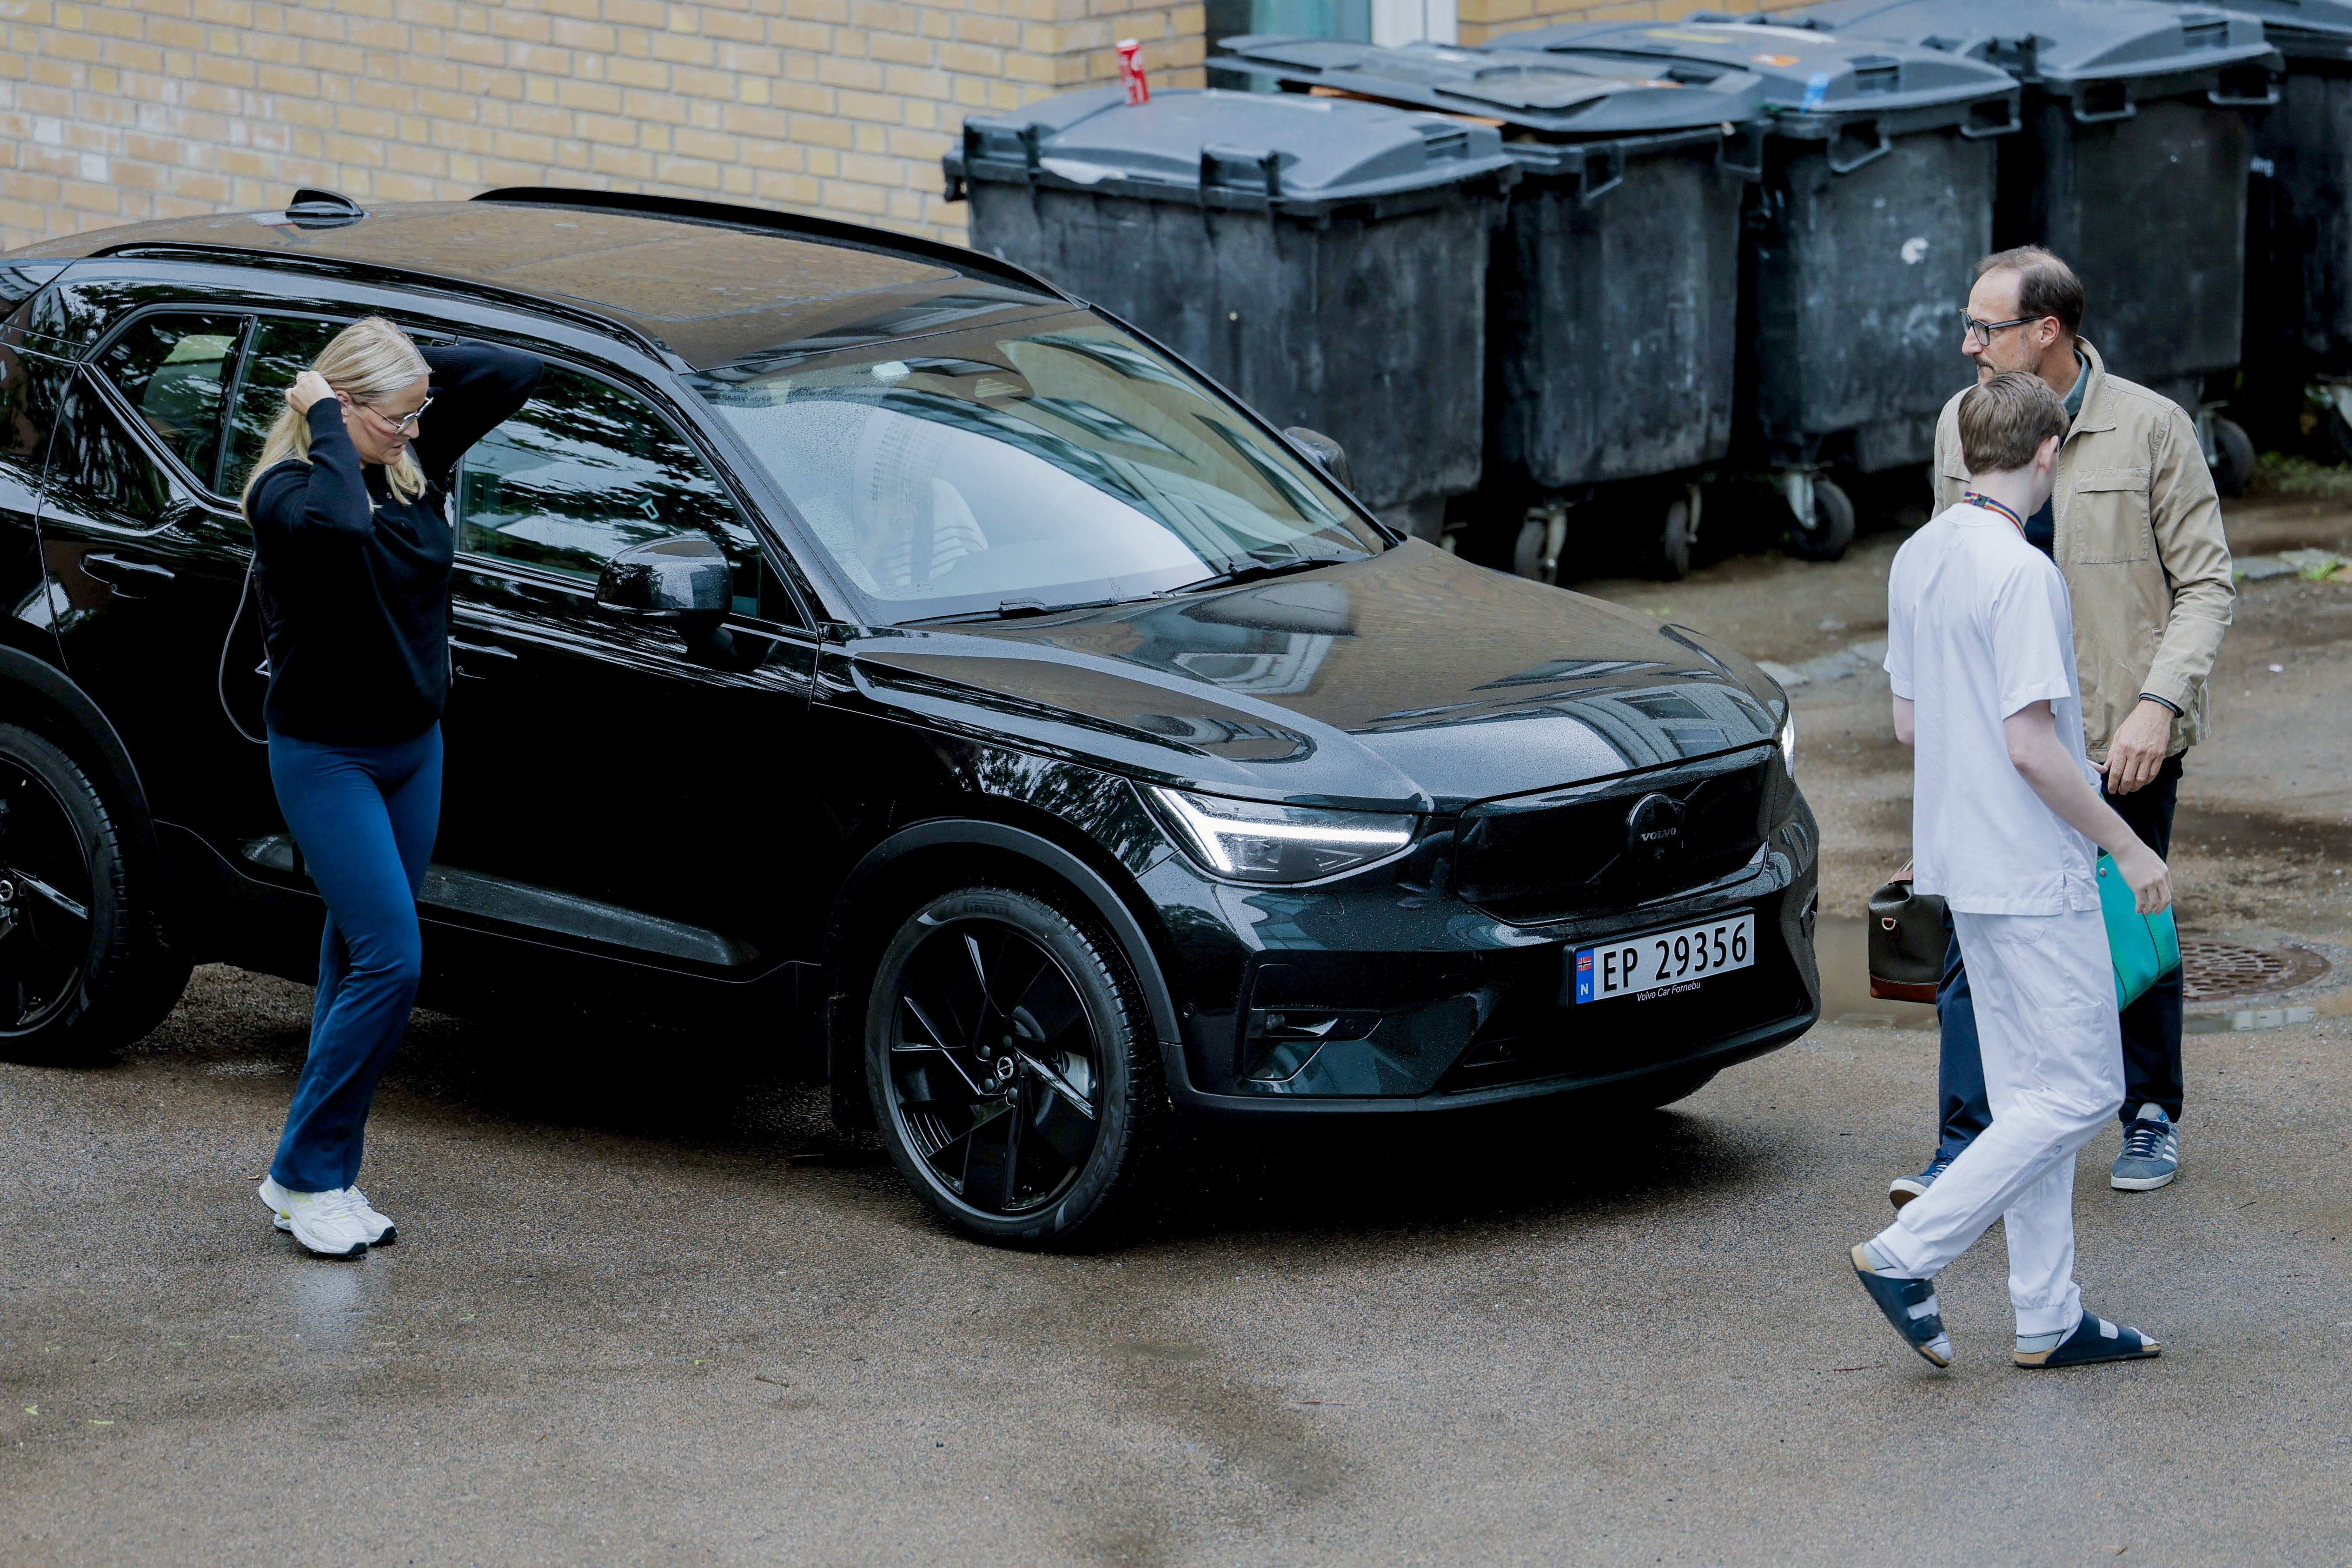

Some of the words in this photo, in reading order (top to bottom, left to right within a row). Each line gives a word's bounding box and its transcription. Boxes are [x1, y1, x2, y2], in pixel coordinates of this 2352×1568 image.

[1640, 827, 1676, 841] VOLVO
[1603, 947, 1638, 992] EP
[1655, 921, 1747, 981] 29356
[1580, 983, 1589, 996] N
[1637, 991, 1656, 1001] Volvo
[1658, 988, 1670, 997] Car
[1672, 981, 1701, 994] Fornebu
